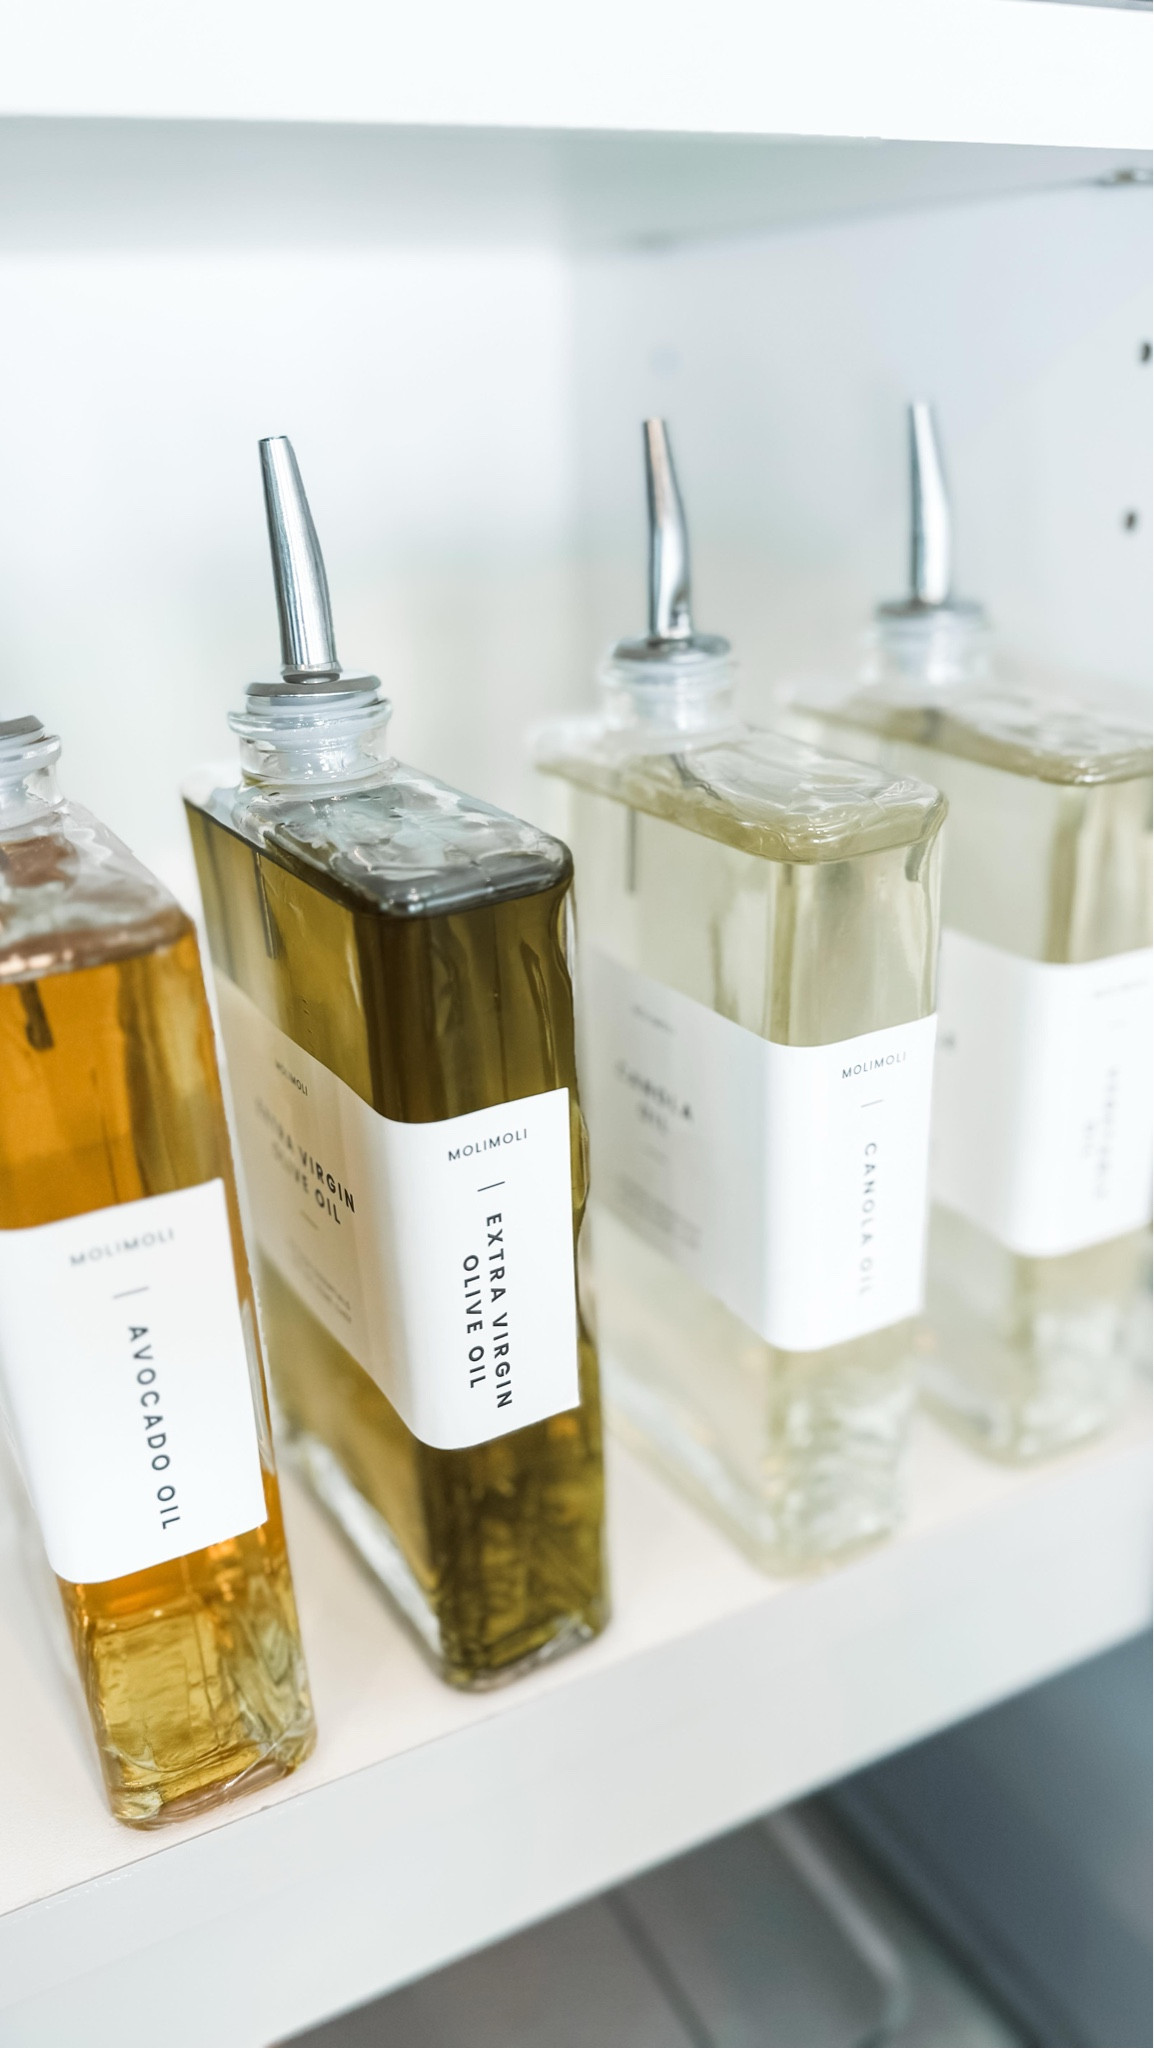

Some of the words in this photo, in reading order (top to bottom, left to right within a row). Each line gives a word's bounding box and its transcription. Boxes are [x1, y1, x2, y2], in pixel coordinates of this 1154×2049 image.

[842, 1051, 907, 1080] MOLIMOLI
[447, 1128, 528, 1162] MOLIMOLI
[299, 1146, 355, 1213] VIRGIN
[314, 1188, 341, 1225] OIL
[861, 1142, 878, 1247] CANOLA
[69, 1227, 174, 1267] MOLIMOLI
[486, 1212, 507, 1303] EXTRA
[463, 1254, 484, 1335] OLIVE
[858, 1256, 874, 1297] OIL
[468, 1345, 487, 1389] OIL
[491, 1311, 513, 1409] VIRGIN
[128, 1325, 171, 1472] AVOCADO
[157, 1485, 181, 1530] OIL
